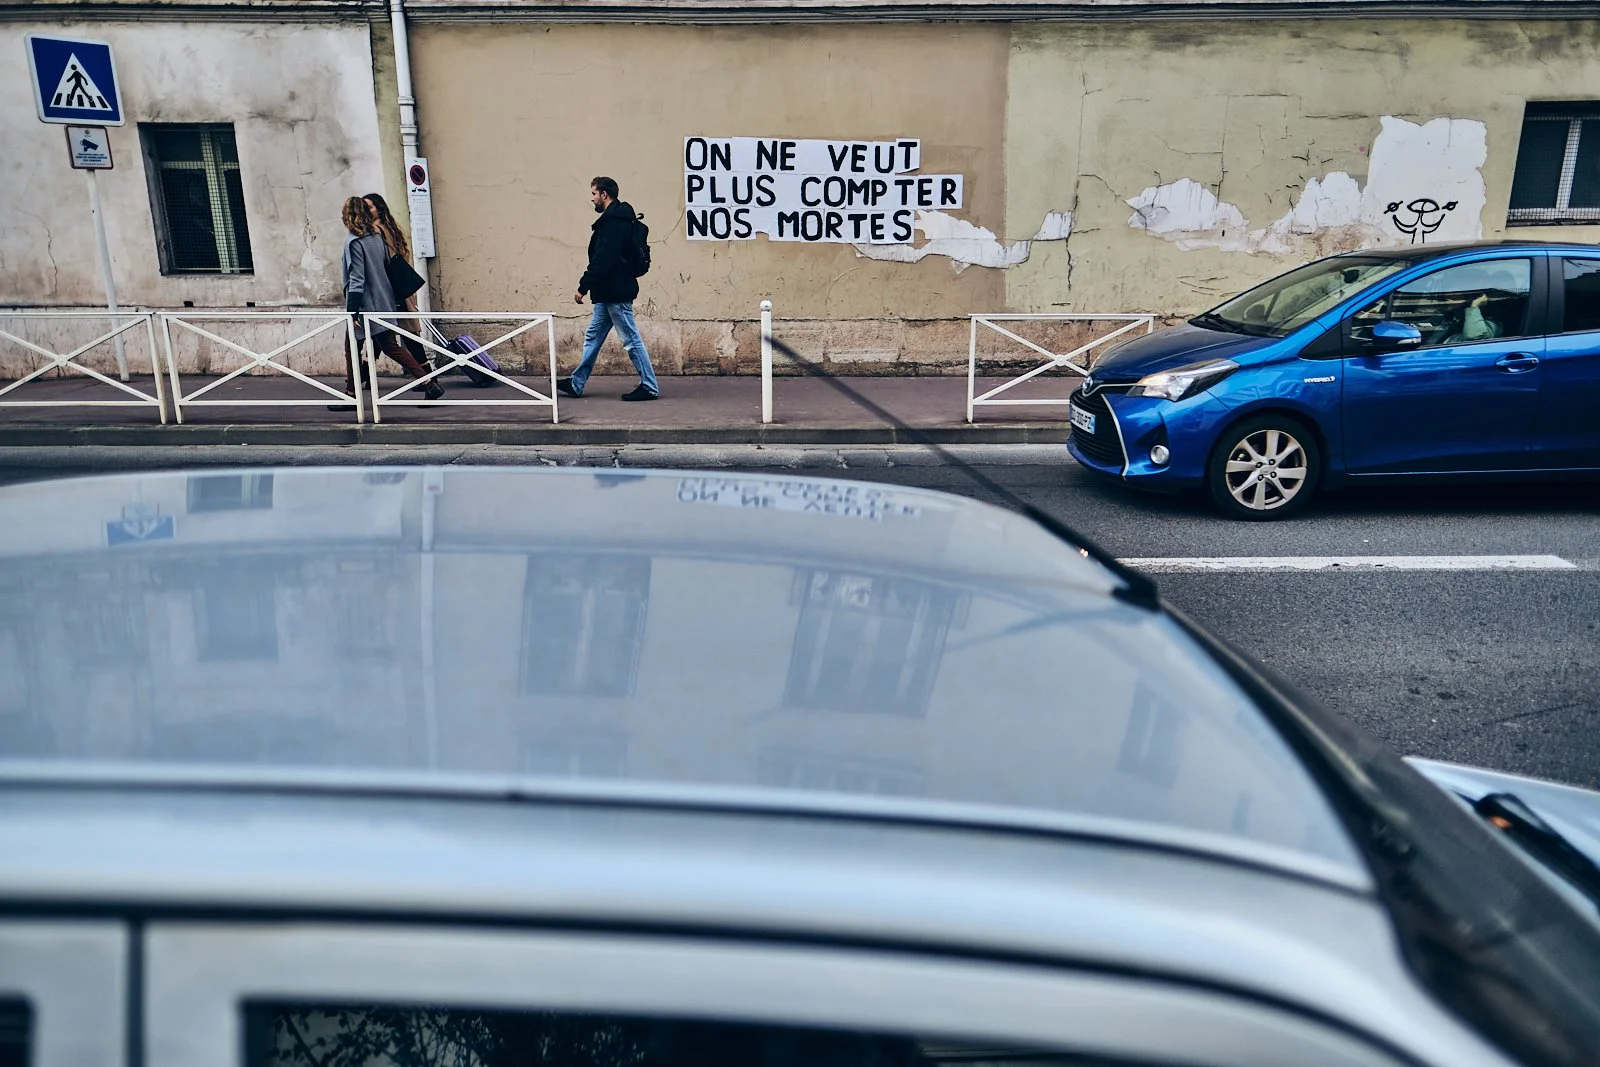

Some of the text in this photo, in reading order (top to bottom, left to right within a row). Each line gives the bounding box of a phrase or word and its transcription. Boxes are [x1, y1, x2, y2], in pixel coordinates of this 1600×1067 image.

[685, 137, 918, 174] ON NE VEUT
[687, 174, 957, 208] PLUS COMPTER
[686, 207, 913, 242] NOS MORTES
